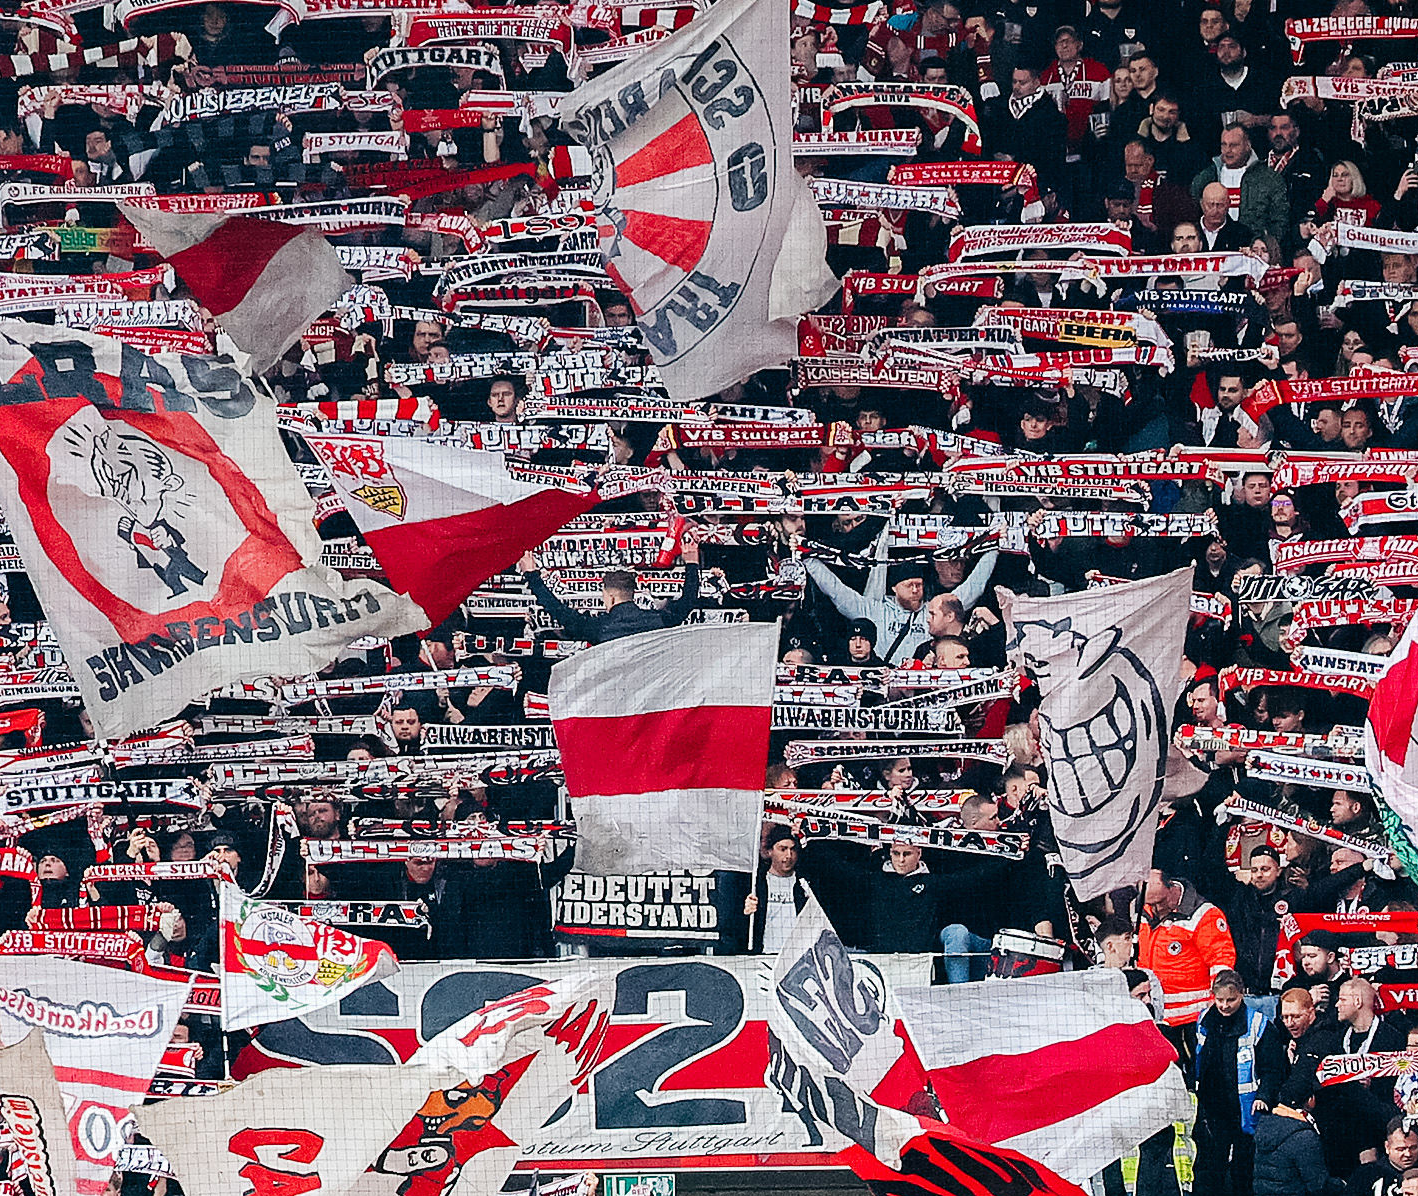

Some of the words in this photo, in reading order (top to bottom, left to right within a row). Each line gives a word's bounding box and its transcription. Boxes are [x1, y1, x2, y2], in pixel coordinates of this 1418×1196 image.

[1164, 289, 1248, 305] STUTTGART
[806, 368, 938, 385] KAISERSLAUTERN
[683, 428, 721, 443] VfB
[729, 427, 822, 444] Stuttgart
[1063, 460, 1202, 478] STUTTGART
[5, 781, 175, 807] STUTTGART
[622, 1130, 786, 1160] Stuttgart
